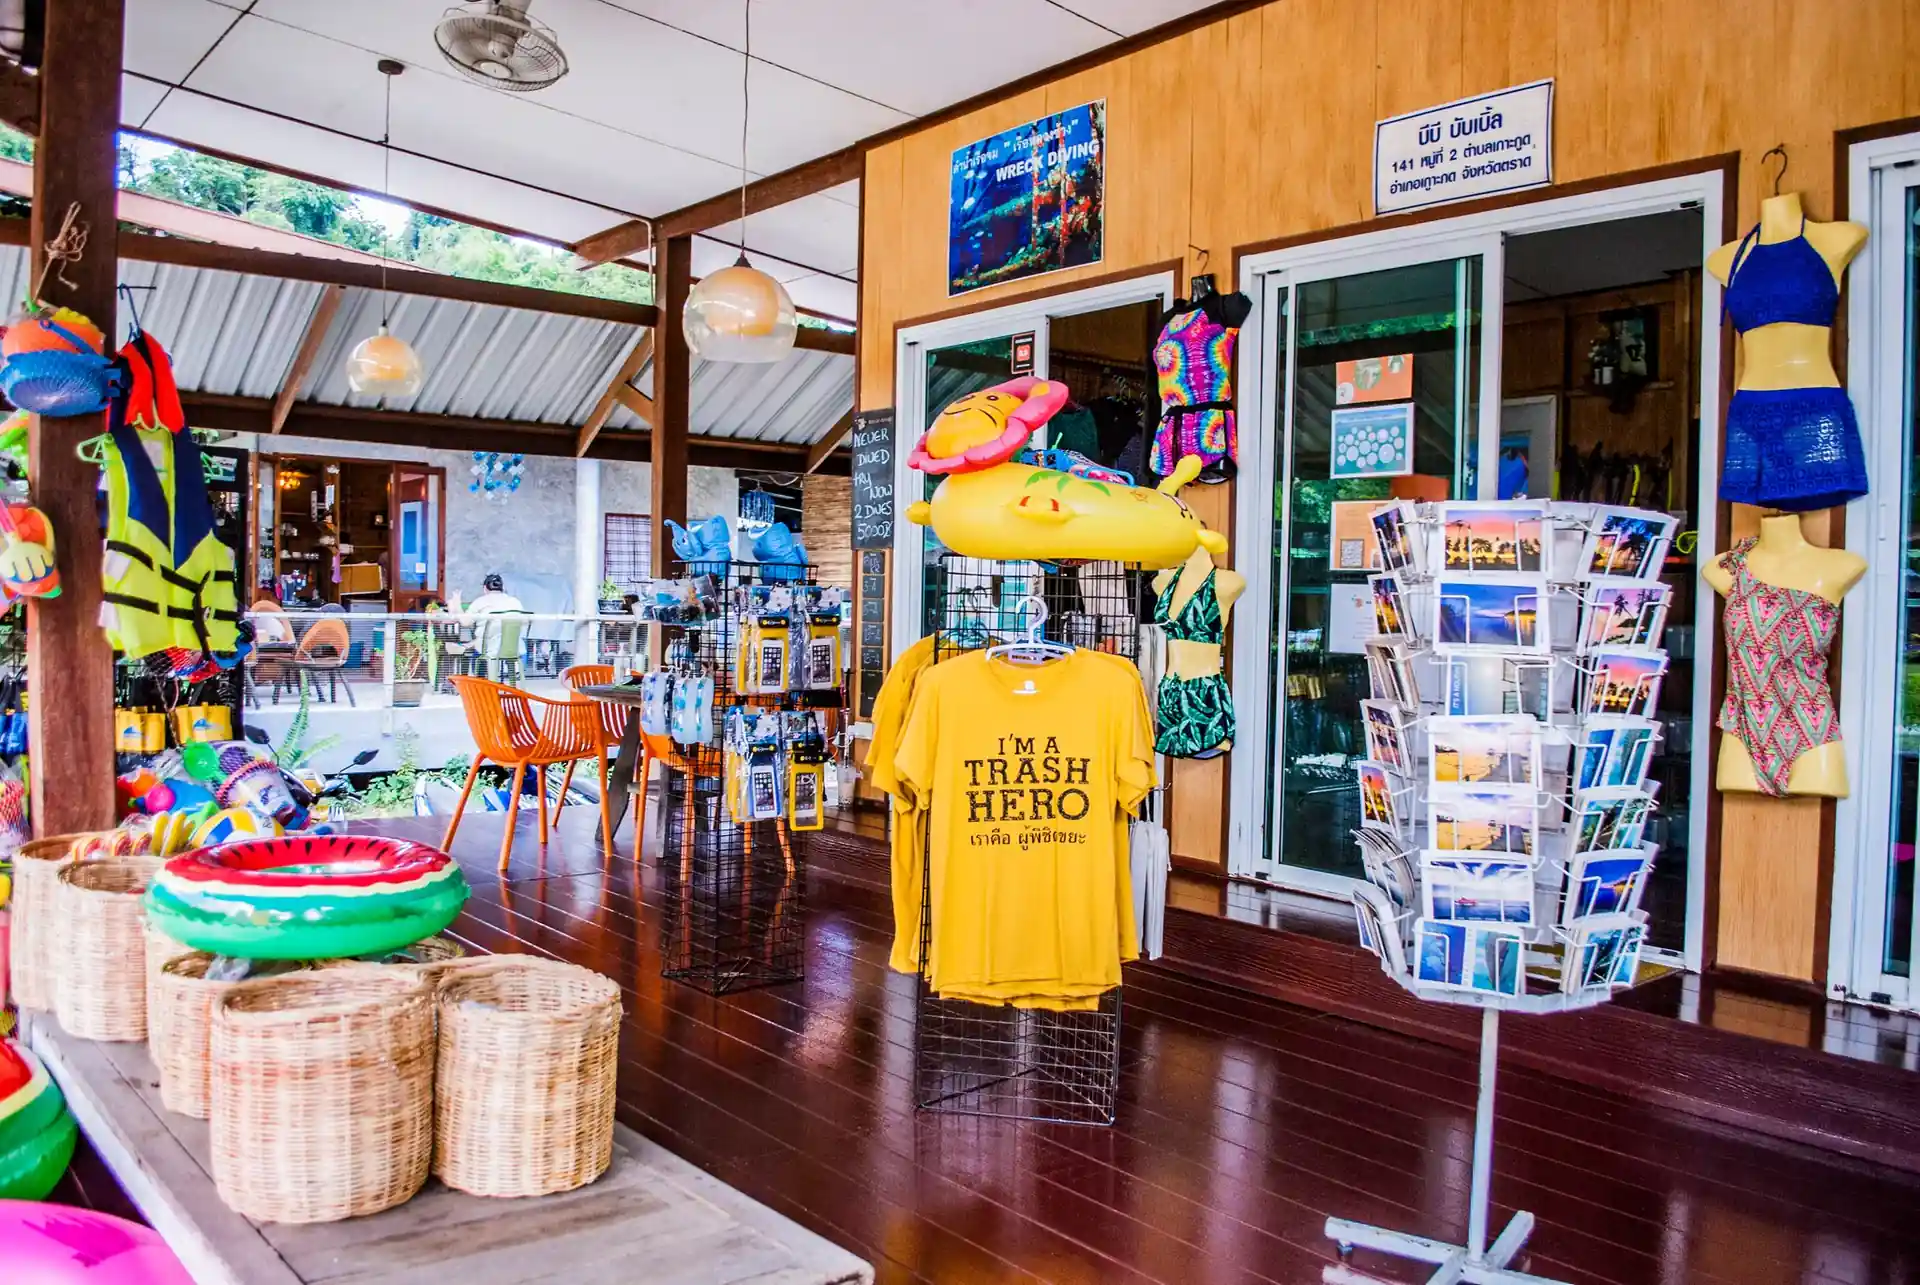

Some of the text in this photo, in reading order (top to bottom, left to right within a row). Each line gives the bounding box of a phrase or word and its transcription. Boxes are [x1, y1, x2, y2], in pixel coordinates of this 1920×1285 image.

[1418, 106, 1503, 146] บีบี บับเบิ้ล
[996, 140, 1100, 182] WRECK DIVING
[1392, 133, 1531, 173] 141 หมู่ที่ 2 ตำบลเกาะกูด
[1462, 155, 1531, 180] จังหวัดตราด
[869, 484, 893, 500] NOW
[854, 504, 863, 519] 2
[998, 733, 1060, 755] I'M A
[964, 756, 1091, 786] TRASH
[966, 788, 1090, 823] HERO
[970, 827, 1011, 846] เราคือ
